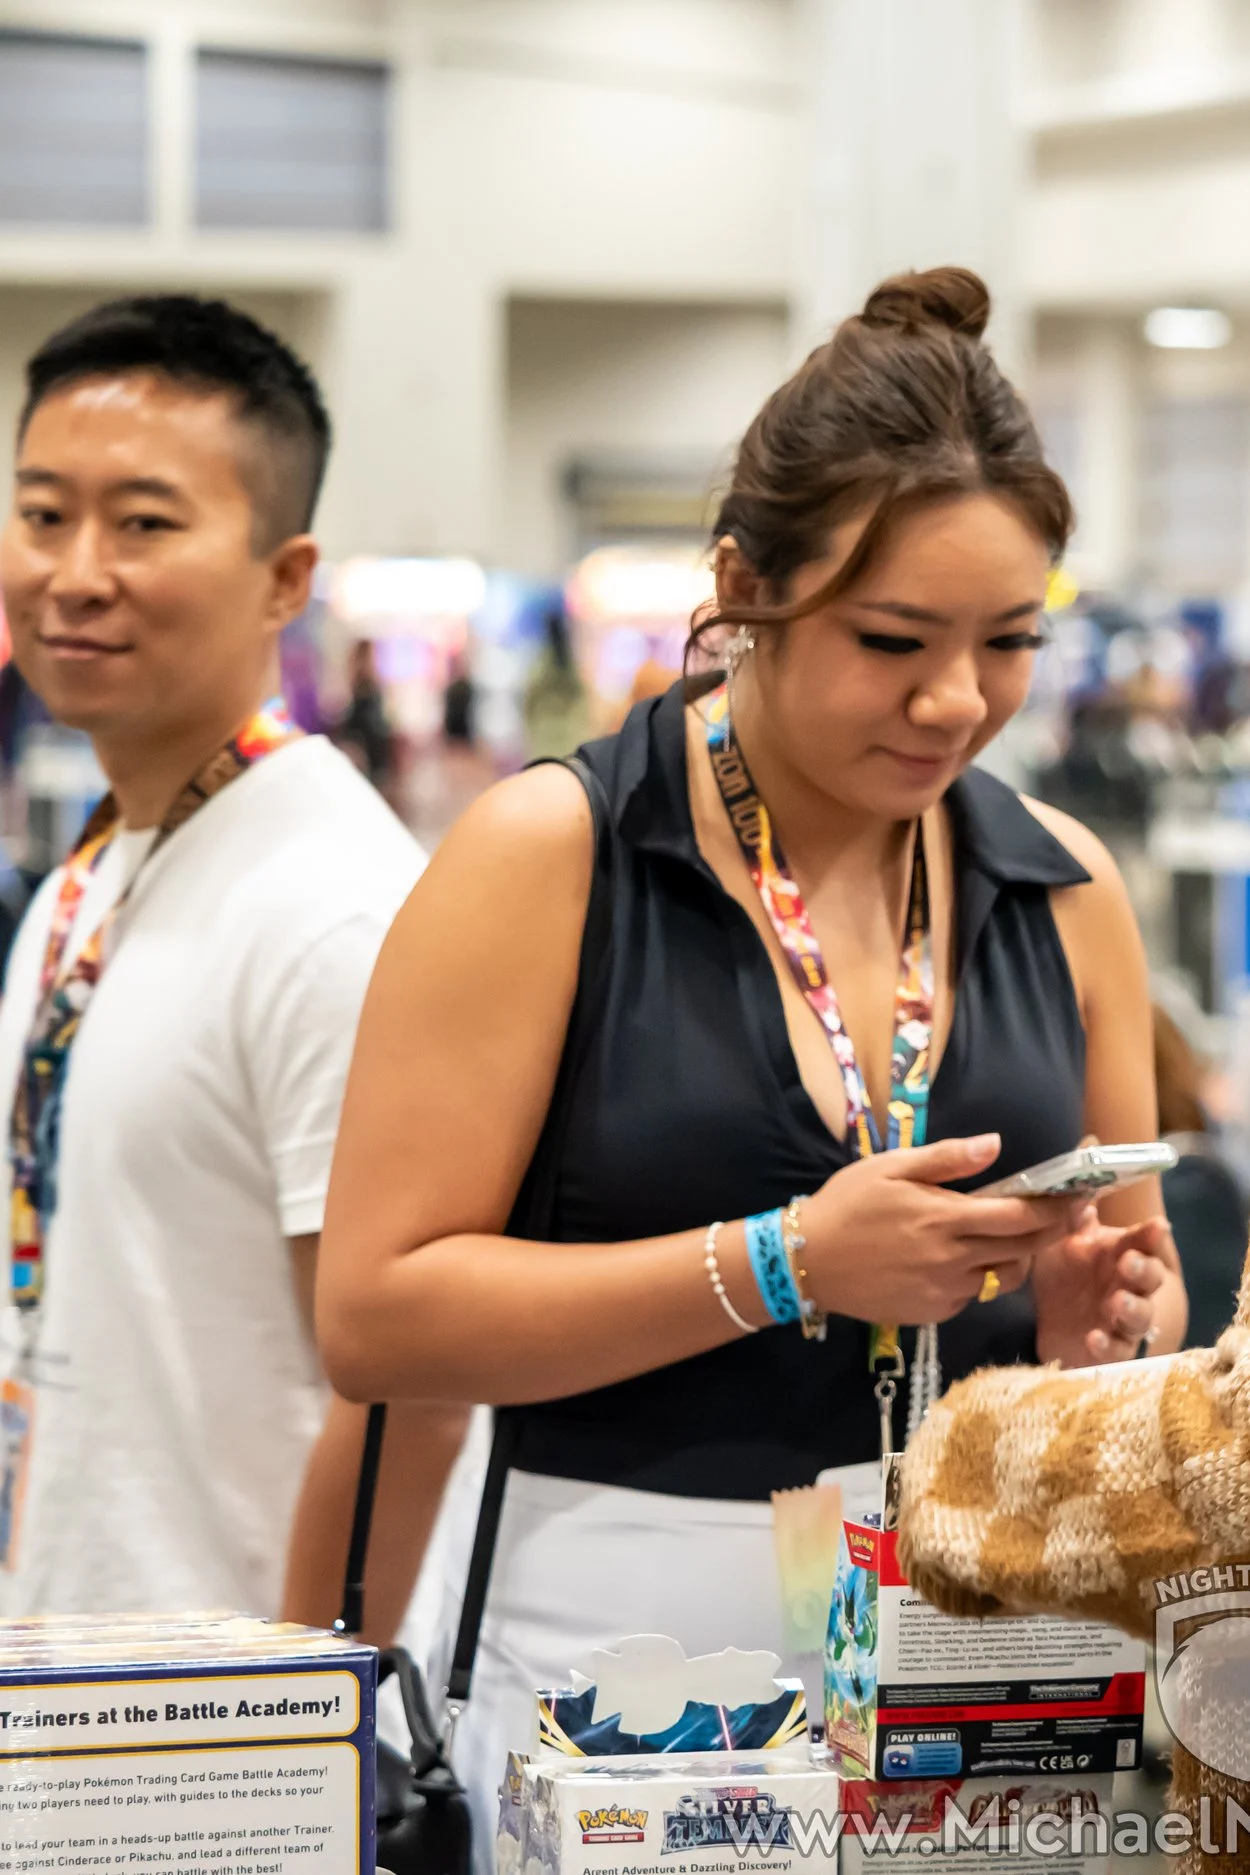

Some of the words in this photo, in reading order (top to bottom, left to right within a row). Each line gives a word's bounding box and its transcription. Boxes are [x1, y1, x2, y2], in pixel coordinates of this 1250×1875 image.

[0, 1709, 90, 1729] Trainers
[97, 1707, 118, 1725] at
[124, 1705, 158, 1722] the
[165, 1701, 229, 1721] Battle
[235, 1695, 340, 1718] Academy!
[890, 1733, 915, 1743] PLAY
[916, 1731, 957, 1742] ONLINE!
[84, 1776, 134, 1788] Pokémon
[136, 1773, 178, 1786] Trading
[180, 1772, 206, 1783] Card
[208, 1771, 239, 1782] Game
[242, 1769, 274, 1780] Battle
[276, 1765, 328, 1778] Academy!
[18, 1800, 38, 1809] two
[40, 1798, 81, 1810] players
[84, 1795, 110, 1806] need
[113, 1795, 124, 1805] to
[126, 1793, 151, 1806] play,
[154, 1791, 177, 1802] with
[180, 1790, 215, 1803] guides
[218, 1789, 229, 1800] to
[231, 1787, 249, 1798] the
[251, 1786, 282, 1798] decks
[285, 1786, 298, 1796] so
[300, 1786, 324, 1798] your
[1, 1842, 12, 1851] to
[41, 1840, 65, 1851] your
[68, 1838, 96, 1848] team
[98, 1835, 109, 1846] in
[111, 1837, 118, 1845] a
[121, 1833, 171, 1845] heads-up
[174, 1831, 205, 1842] battle
[208, 1829, 247, 1842] against
[250, 1826, 291, 1838] another
[294, 1824, 335, 1836] Trainer.
[58, 1855, 112, 1867] Cinderace
[114, 1854, 126, 1864] or
[129, 1851, 175, 1863] Pikachu,
[177, 1849, 197, 1860] and
[200, 1847, 223, 1858] lead
[226, 1849, 232, 1857] a
[235, 1844, 281, 1857] different
[284, 1843, 311, 1854] team
[313, 1842, 324, 1853] of
[210, 1865, 233, 1875] with
[236, 1863, 253, 1874] the
[256, 1863, 283, 1874] best!
[621, 1865, 676, 1875] Adventure
[690, 1863, 735, 1874] Dazzling
[738, 1859, 792, 1871] Discovery!
